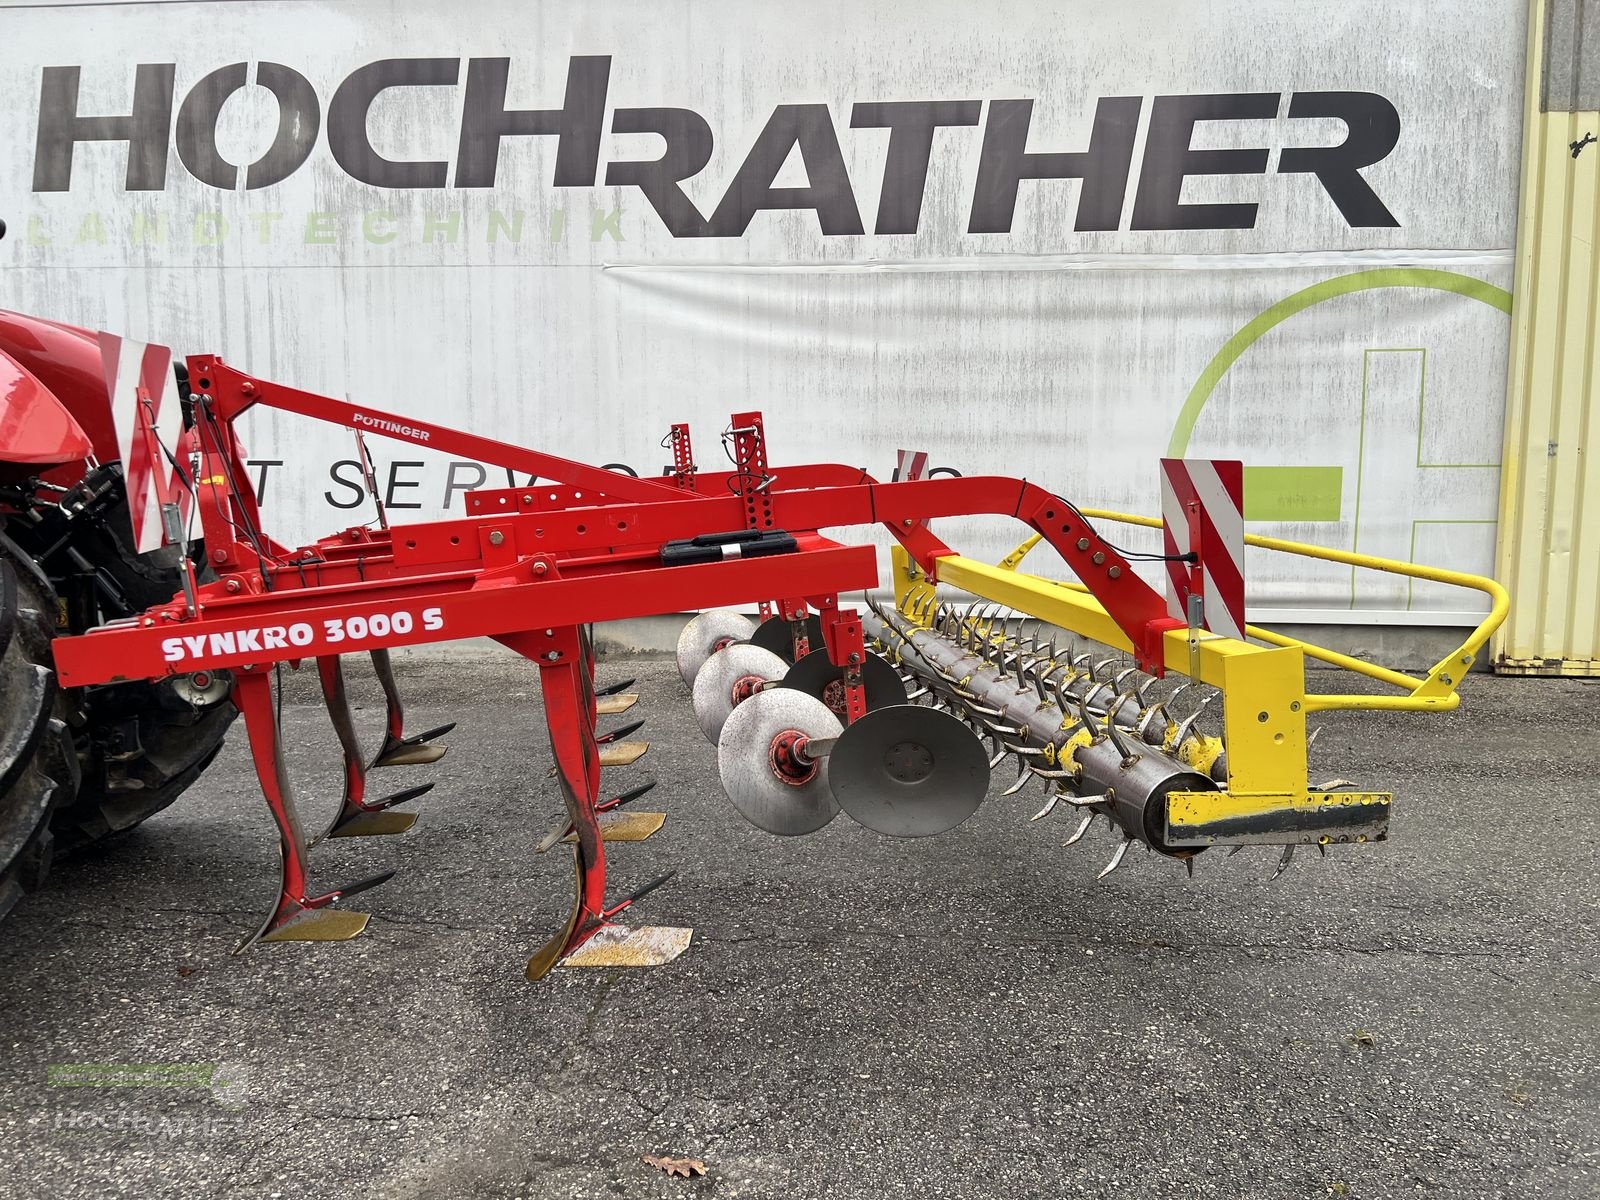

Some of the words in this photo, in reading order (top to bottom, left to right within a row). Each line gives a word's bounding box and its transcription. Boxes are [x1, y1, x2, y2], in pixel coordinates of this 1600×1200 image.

[33, 55, 1402, 238] HOCHRATHER
[27, 208, 626, 246] LANDTECHNIK
[161, 622, 315, 662] SYNKRO
[323, 610, 414, 643] 3000
[422, 607, 444, 631] S
